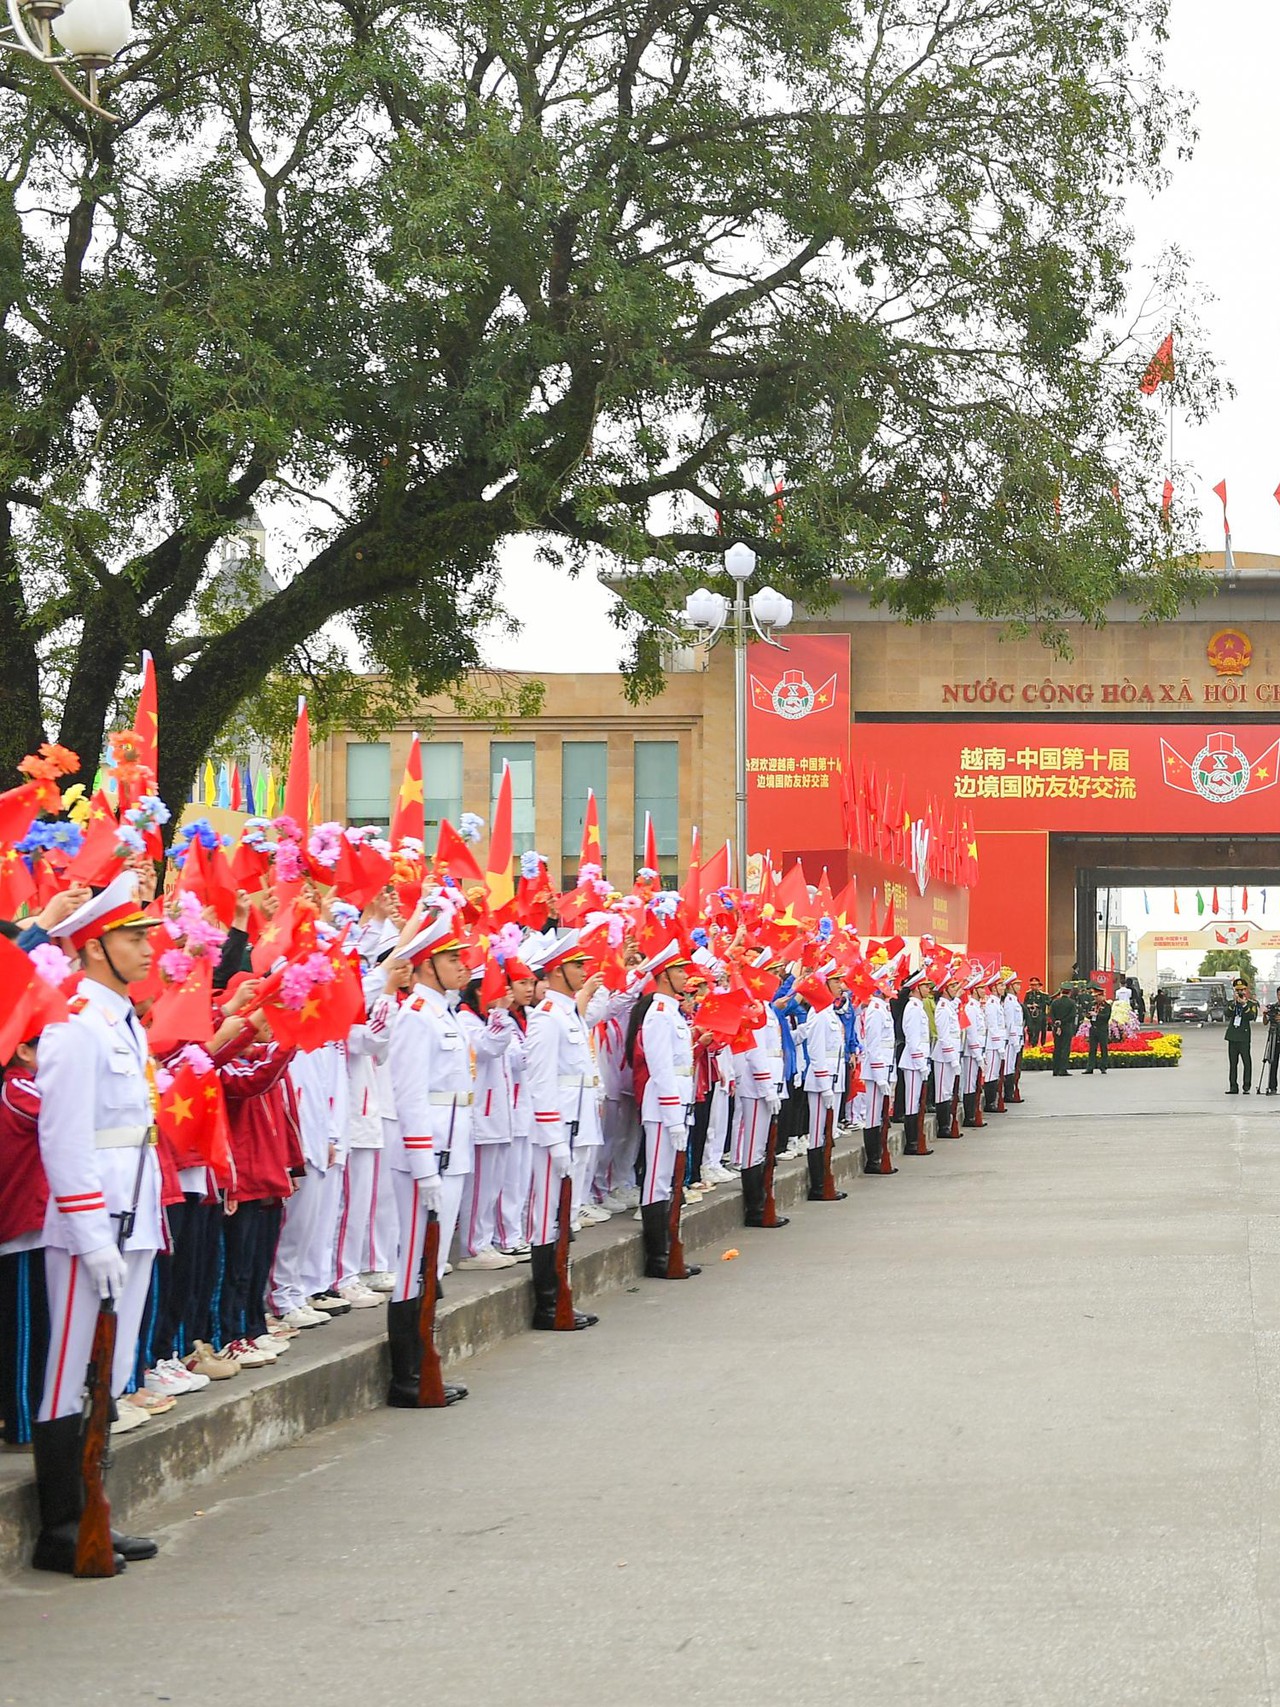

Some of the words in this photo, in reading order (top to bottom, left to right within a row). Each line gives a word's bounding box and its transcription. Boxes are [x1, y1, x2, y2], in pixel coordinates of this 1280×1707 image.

[943, 678, 1014, 703] NƯỚC
[1021, 678, 1094, 709] CỘNG
[1101, 678, 1154, 703] HÒA
[1158, 678, 1193, 703] XÃ
[1203, 678, 1247, 708] HỘI
[960, 747, 1129, 771] 越南-中国第十届
[757, 774, 829, 788] 边境国防友好交流
[954, 775, 1136, 798] 边境国防友好交流
